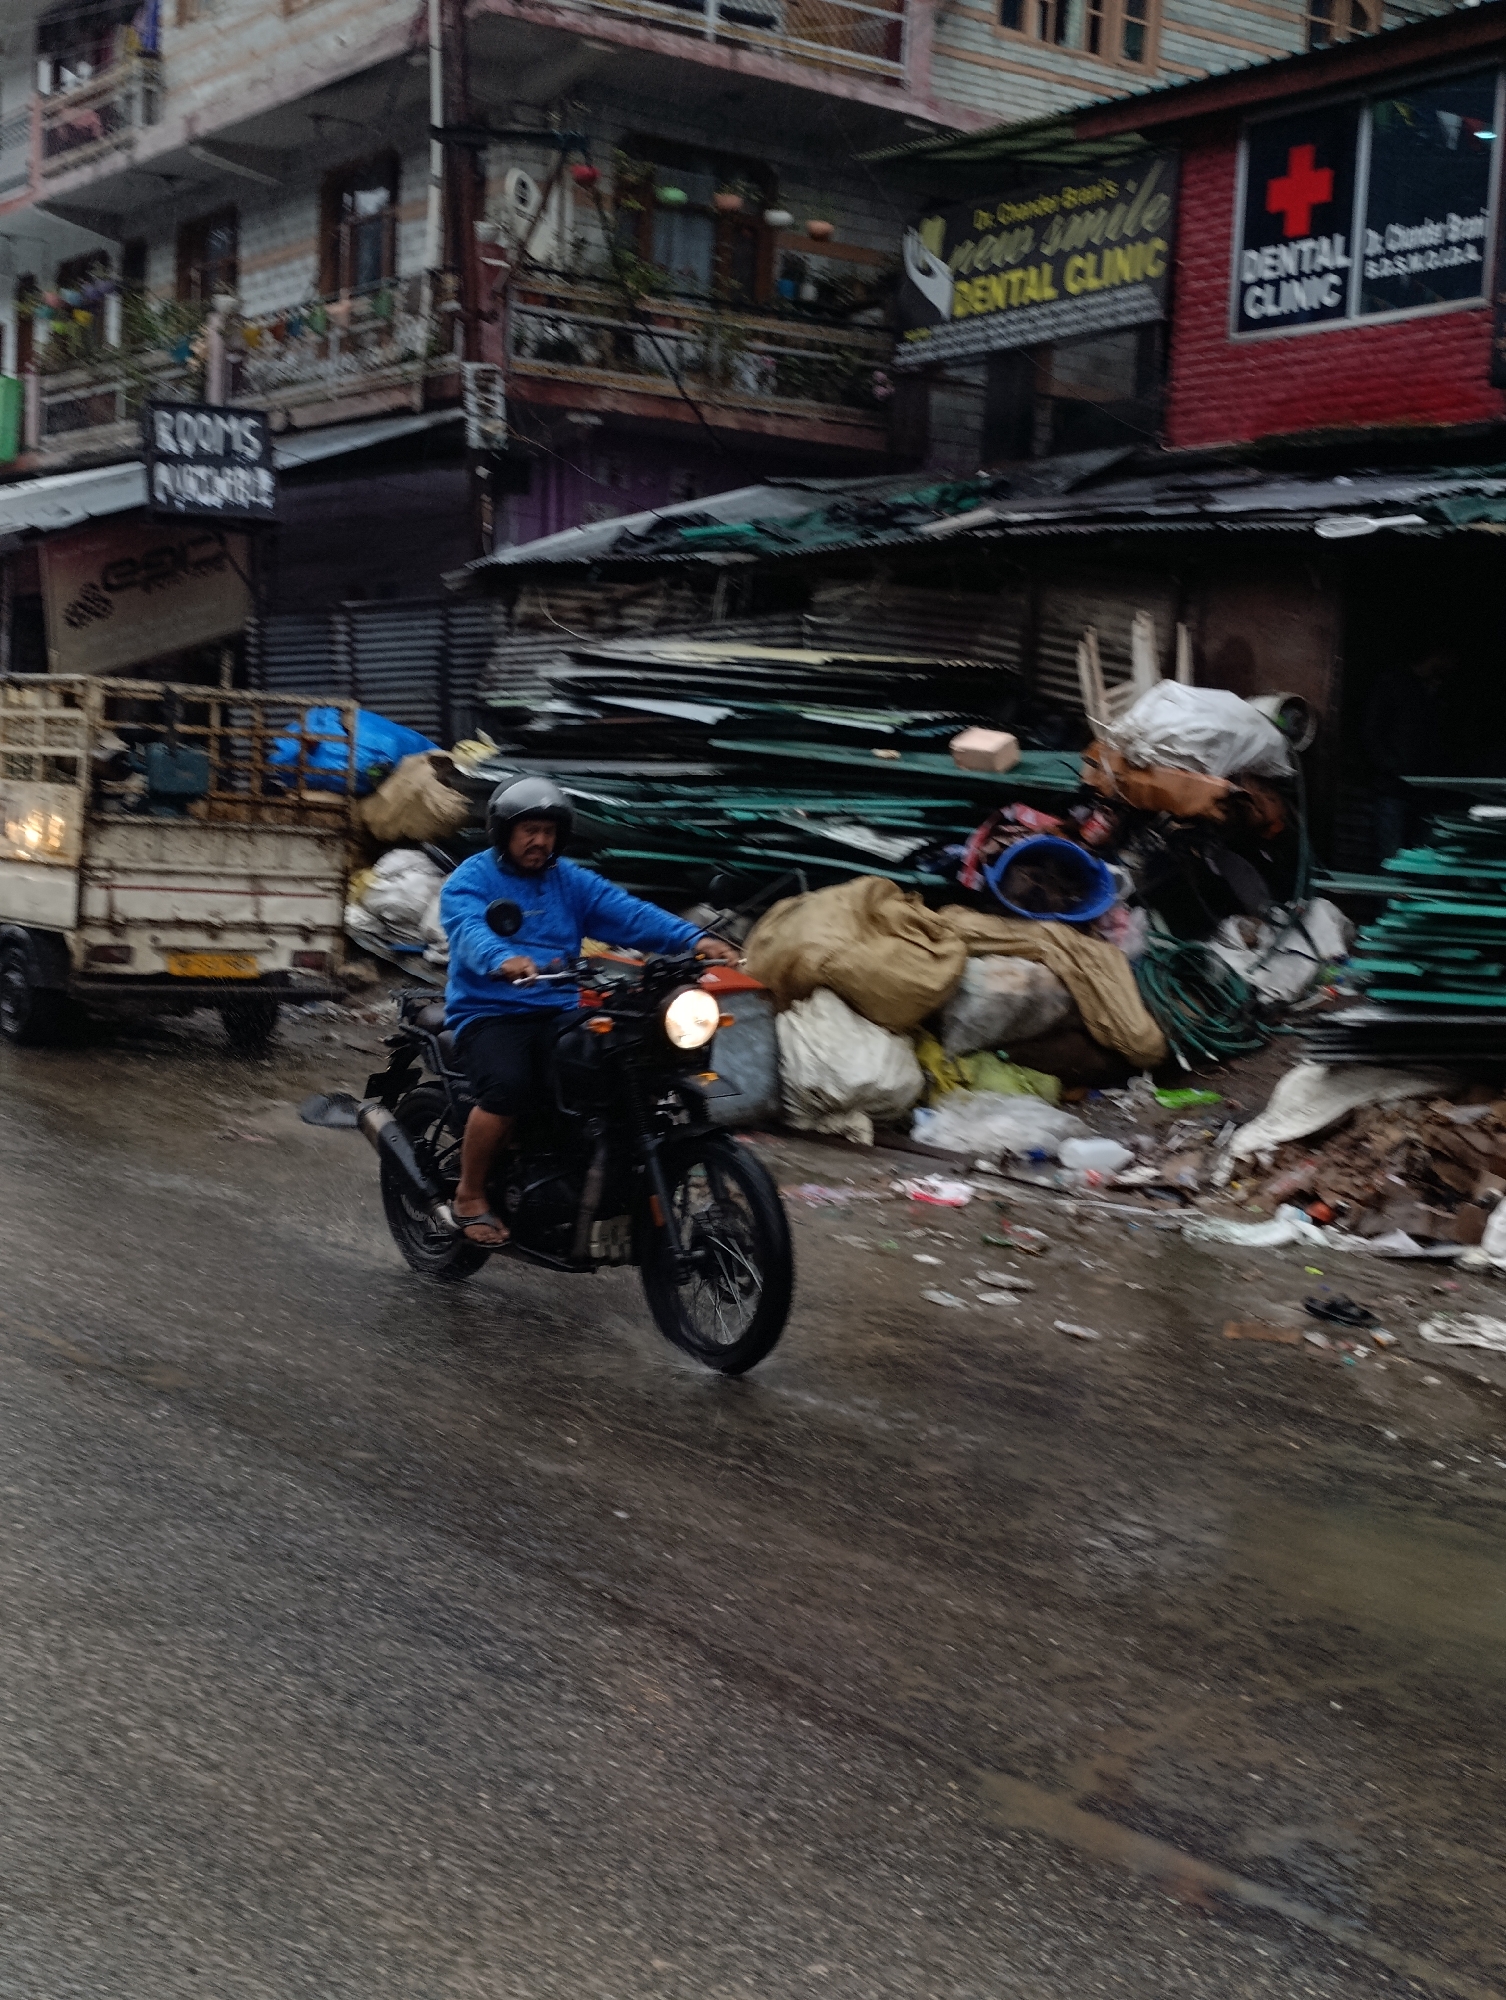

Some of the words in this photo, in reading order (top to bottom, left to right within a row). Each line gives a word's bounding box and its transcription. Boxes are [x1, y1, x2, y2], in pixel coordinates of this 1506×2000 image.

[1040, 159, 1171, 257] smile
[953, 262, 1058, 318] DENTAL
[1063, 237, 1168, 295] CLINIC
[1240, 233, 1350, 284] DENTAL
[1244, 273, 1343, 319] CLINIC
[153, 410, 263, 463] ROOMS
